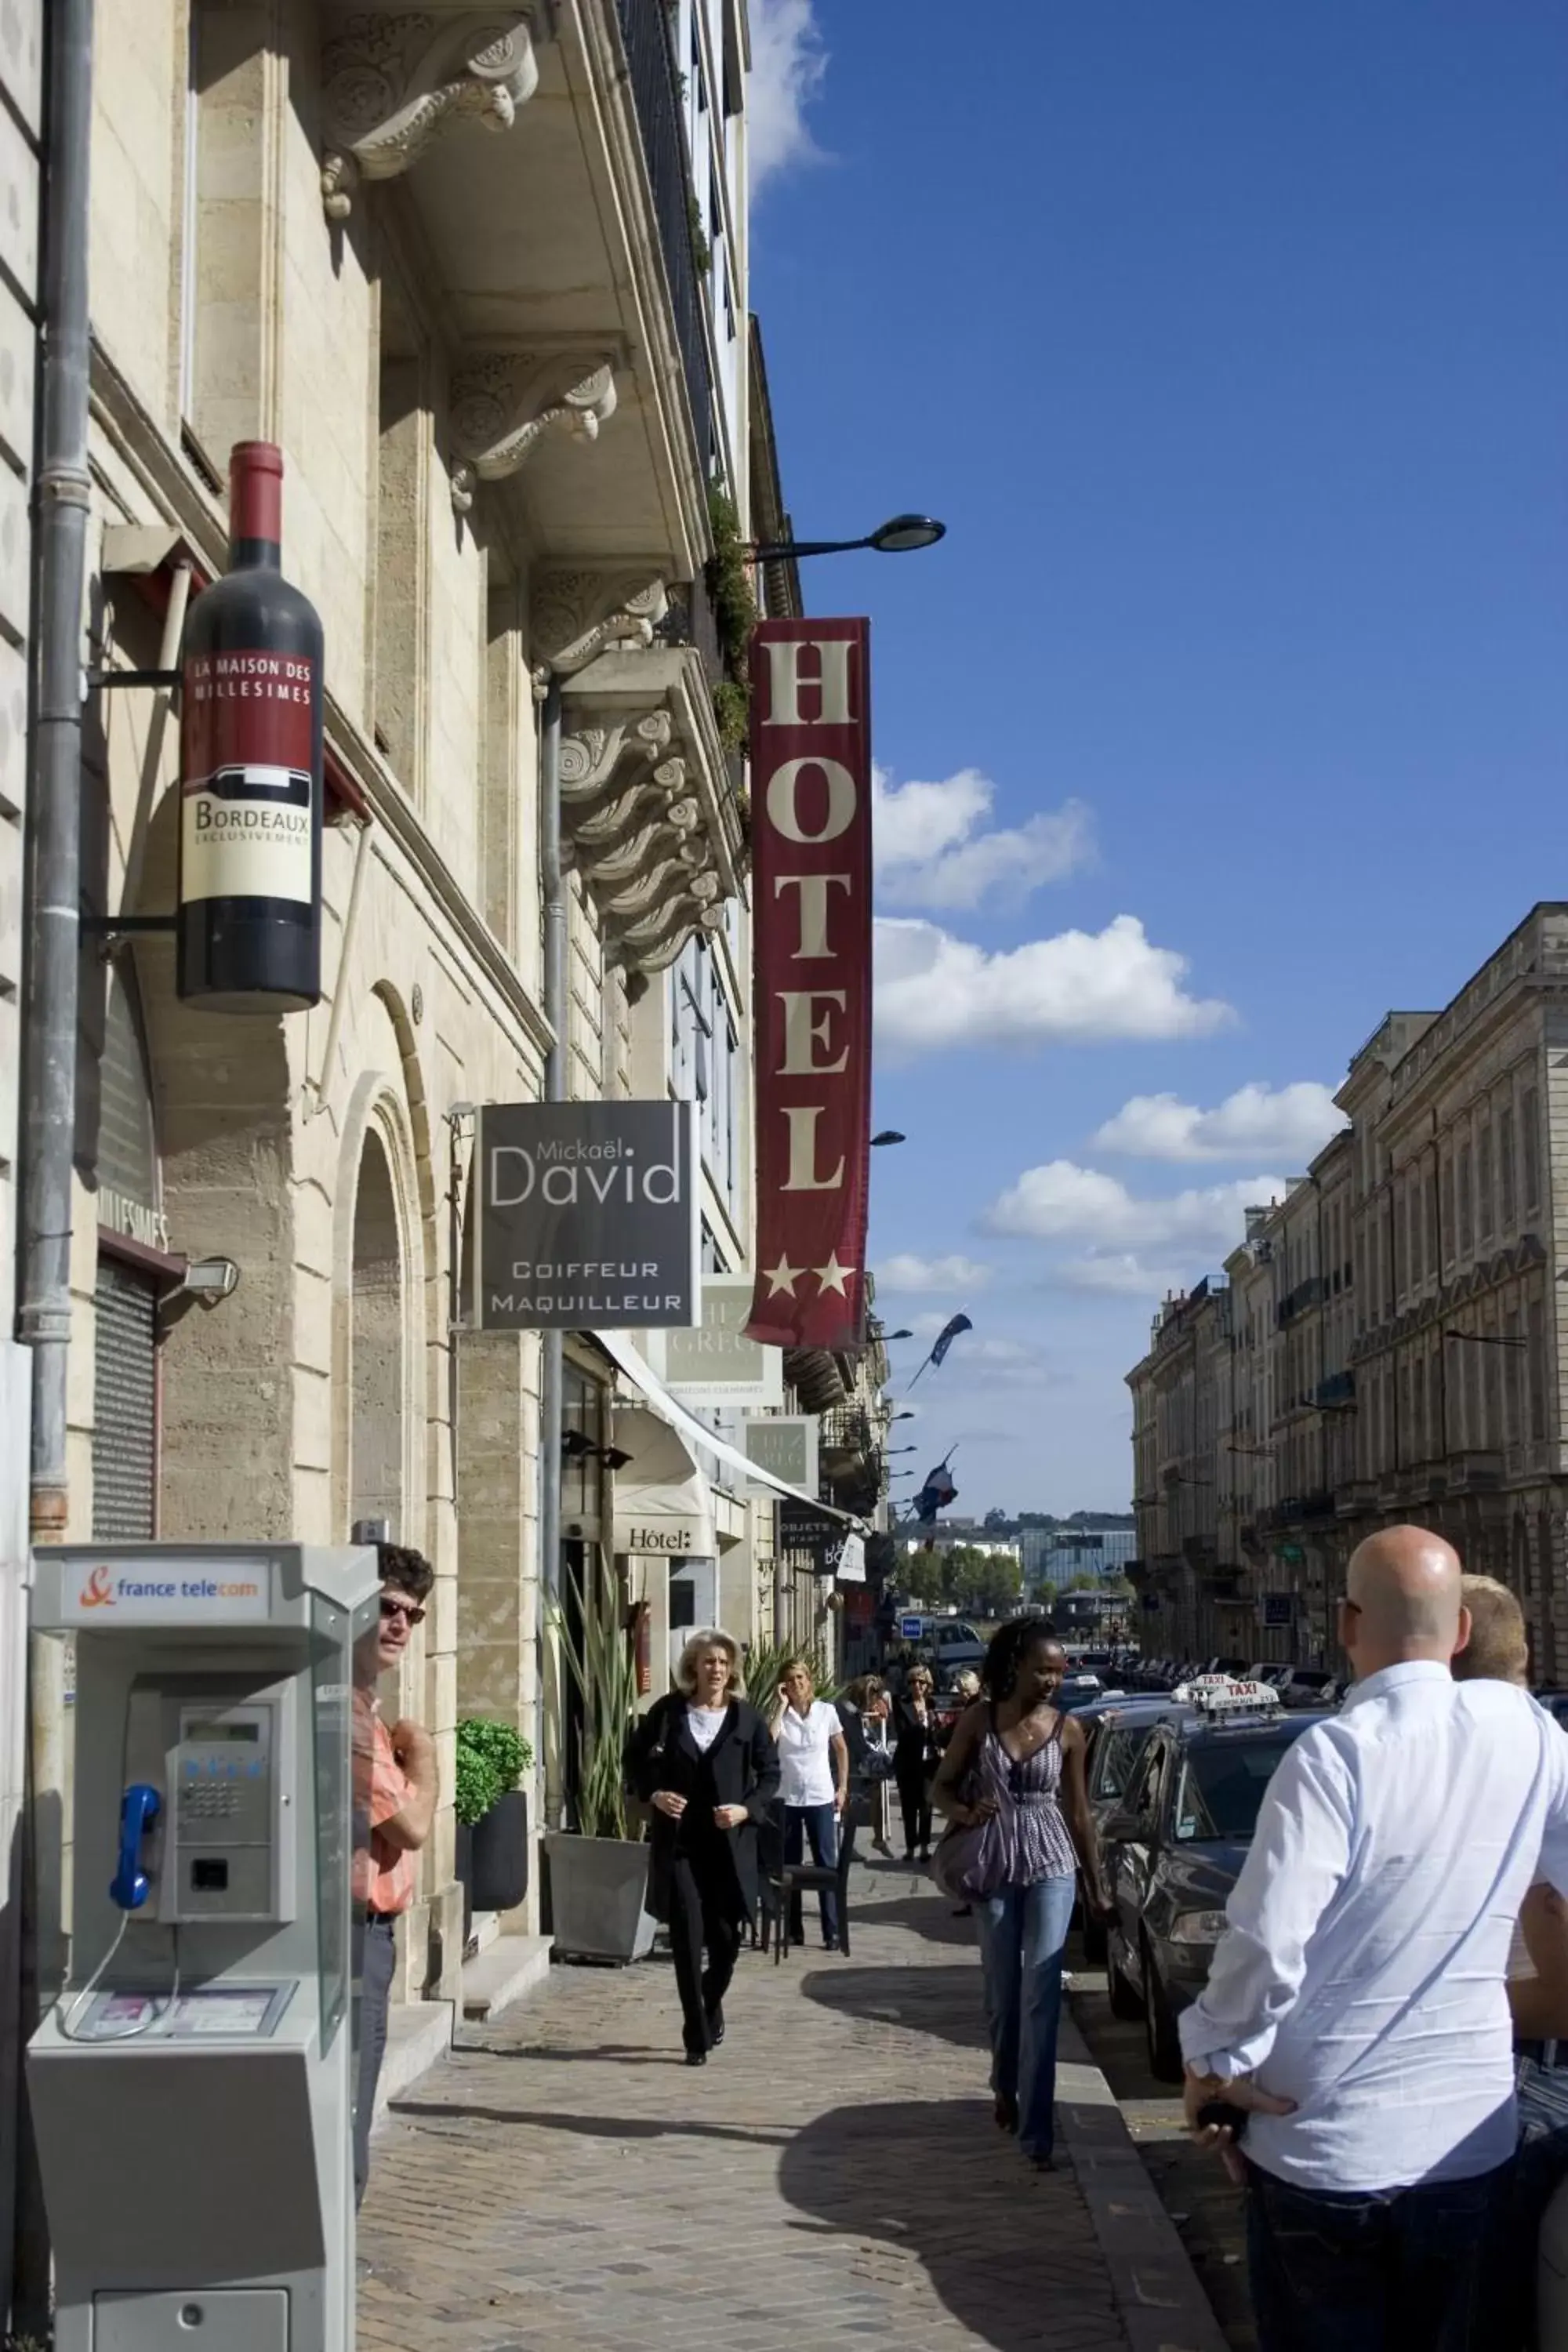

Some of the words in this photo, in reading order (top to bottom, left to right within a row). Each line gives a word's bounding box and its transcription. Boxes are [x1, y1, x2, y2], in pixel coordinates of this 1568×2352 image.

[195, 662, 211, 677] LA
[216, 658, 278, 676] MAISON
[285, 661, 310, 682] DES
[195, 681, 310, 705] MILLESIMES
[196, 800, 308, 833] BORDEAUX
[759, 640, 859, 1192] HOTEL
[491, 1104, 680, 1206] David
[536, 1138, 622, 1160] Mickaël
[512, 1261, 659, 1279] COIFFEUR
[491, 1294, 681, 1314] MAQUILLEUR
[630, 1528, 683, 1549] Hôtel
[118, 1579, 176, 1597] france
[181, 1578, 259, 1597] telecom
[1202, 1675, 1225, 1685] TAXI
[1225, 1682, 1258, 1696] TAXI
